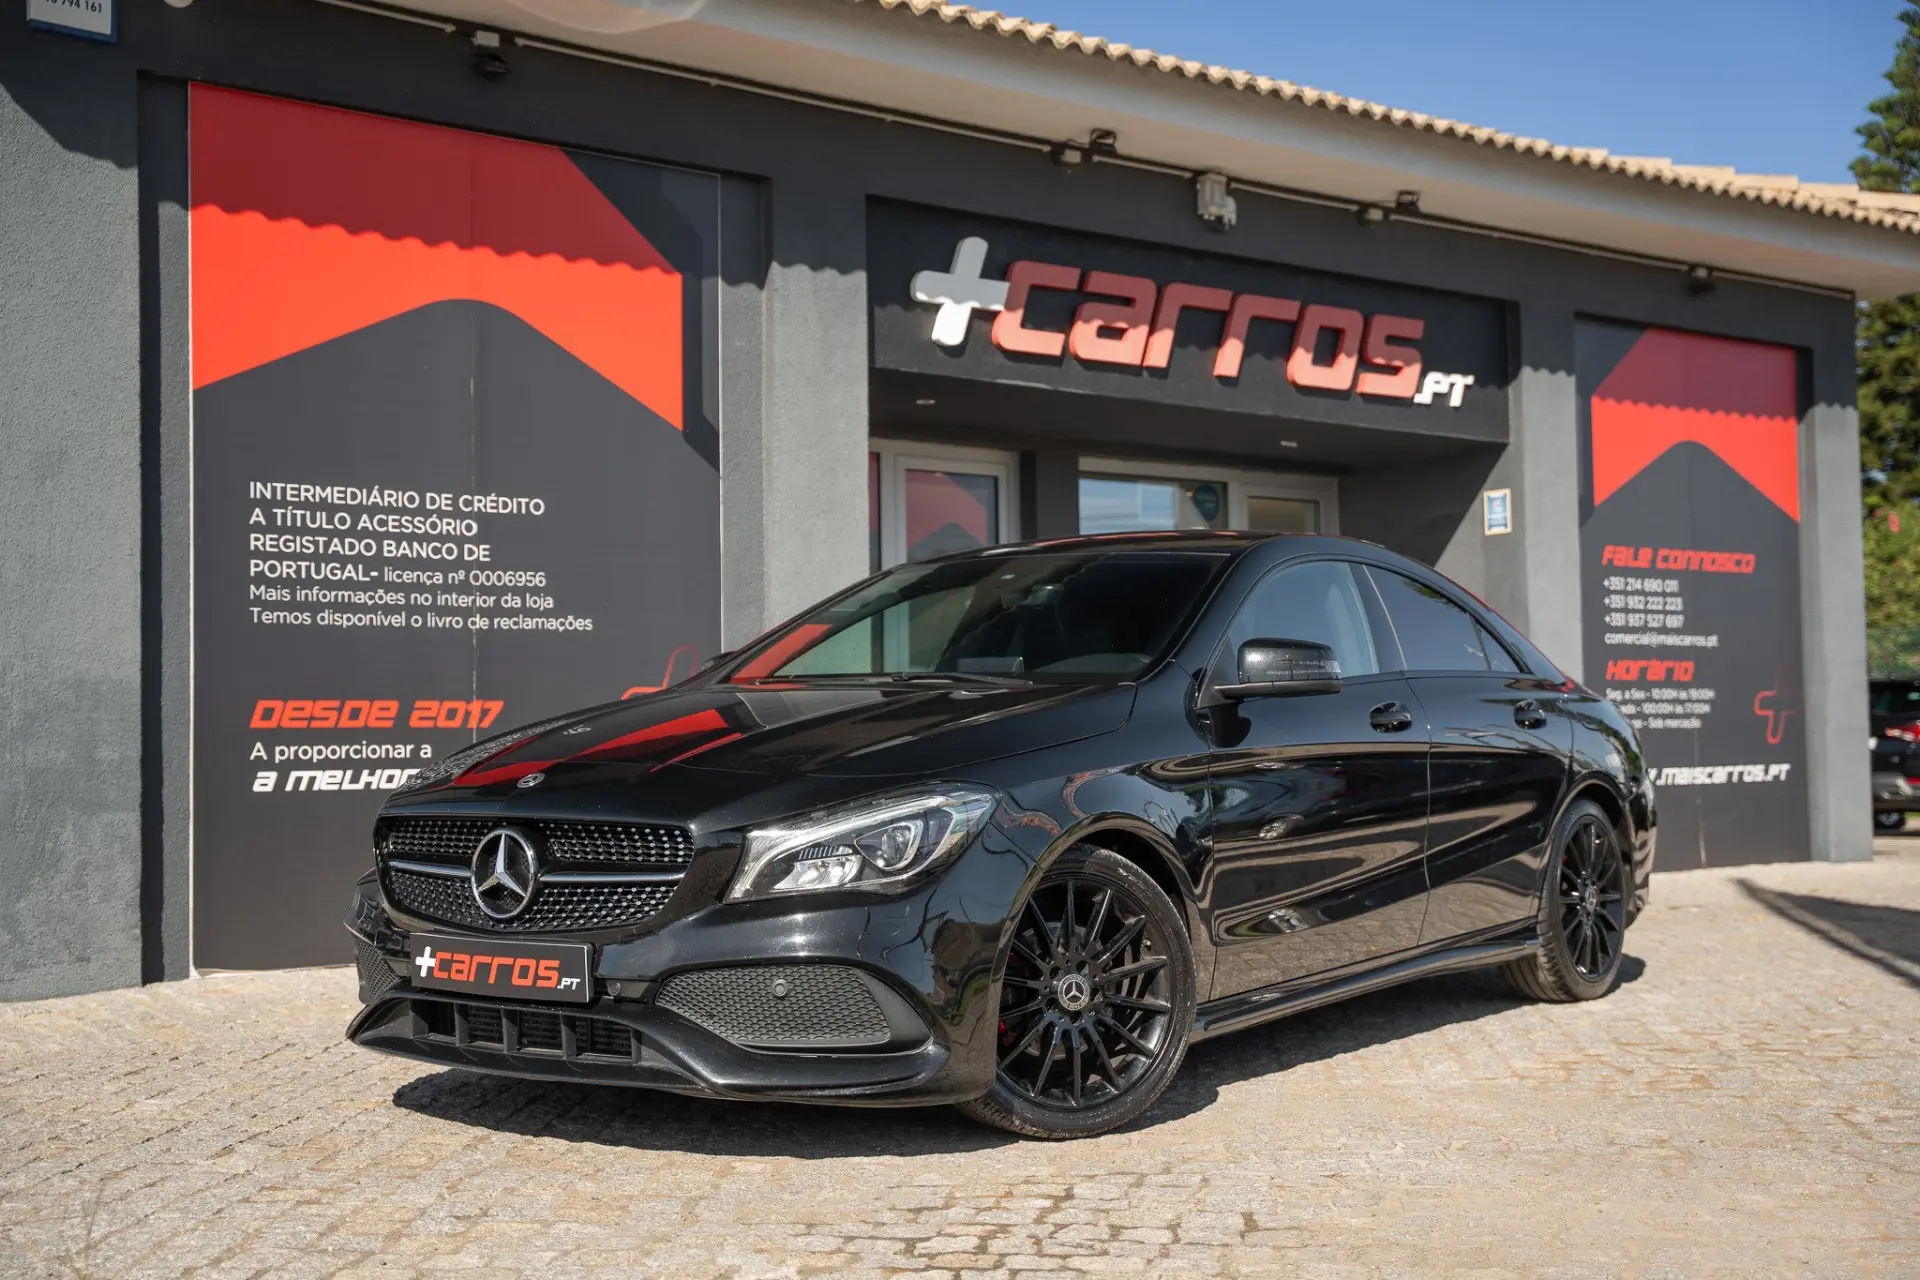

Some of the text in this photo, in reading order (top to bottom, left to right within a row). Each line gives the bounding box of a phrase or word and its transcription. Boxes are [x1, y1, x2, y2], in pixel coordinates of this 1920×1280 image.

[84, 0, 103, 13] 161
[250, 481, 545, 515] INTERMEDIÁRIO DE CRÉDITO
[249, 506, 478, 537] A TÍTULO ACESSÓRIO
[250, 533, 491, 562] REGISTADO BANCO DE
[384, 566, 443, 586] licença
[448, 569, 466, 585] nº
[469, 570, 547, 587] 0006956
[250, 584, 554, 611] Mais informações no interior da loja
[249, 607, 593, 632] Temos disponível o livro de reclamações
[408, 699, 504, 729] 2017
[249, 740, 432, 763] A proporcionar a
